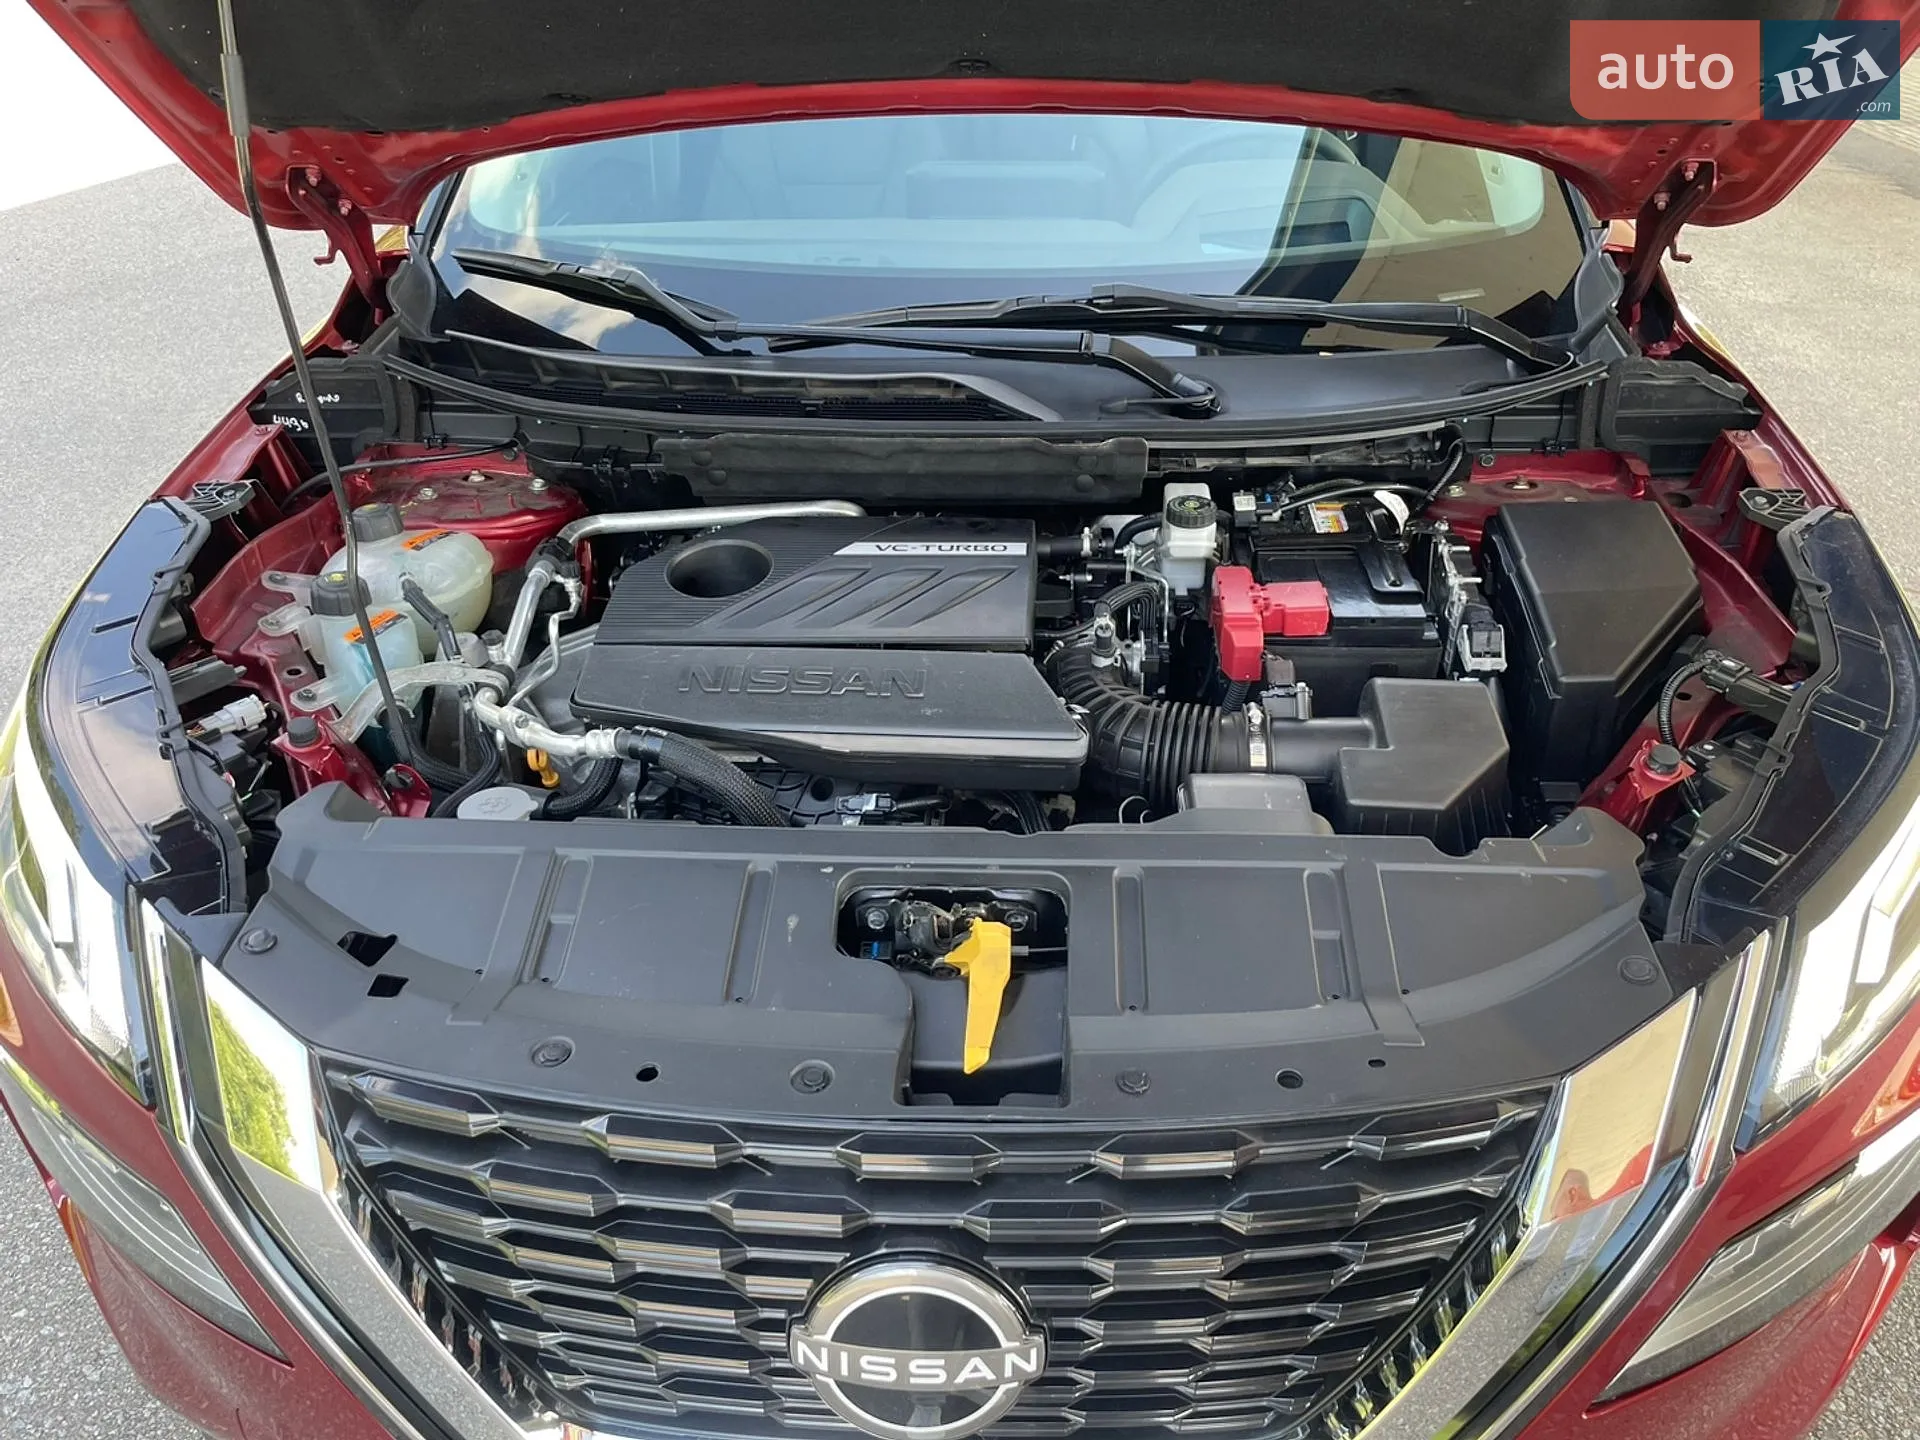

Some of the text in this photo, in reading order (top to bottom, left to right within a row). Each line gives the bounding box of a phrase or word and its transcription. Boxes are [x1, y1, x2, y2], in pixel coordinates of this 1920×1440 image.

[875, 544, 1008, 552] VC-TURBO
[678, 664, 928, 698] NISSAN
[797, 1340, 1038, 1384] NISSAN
